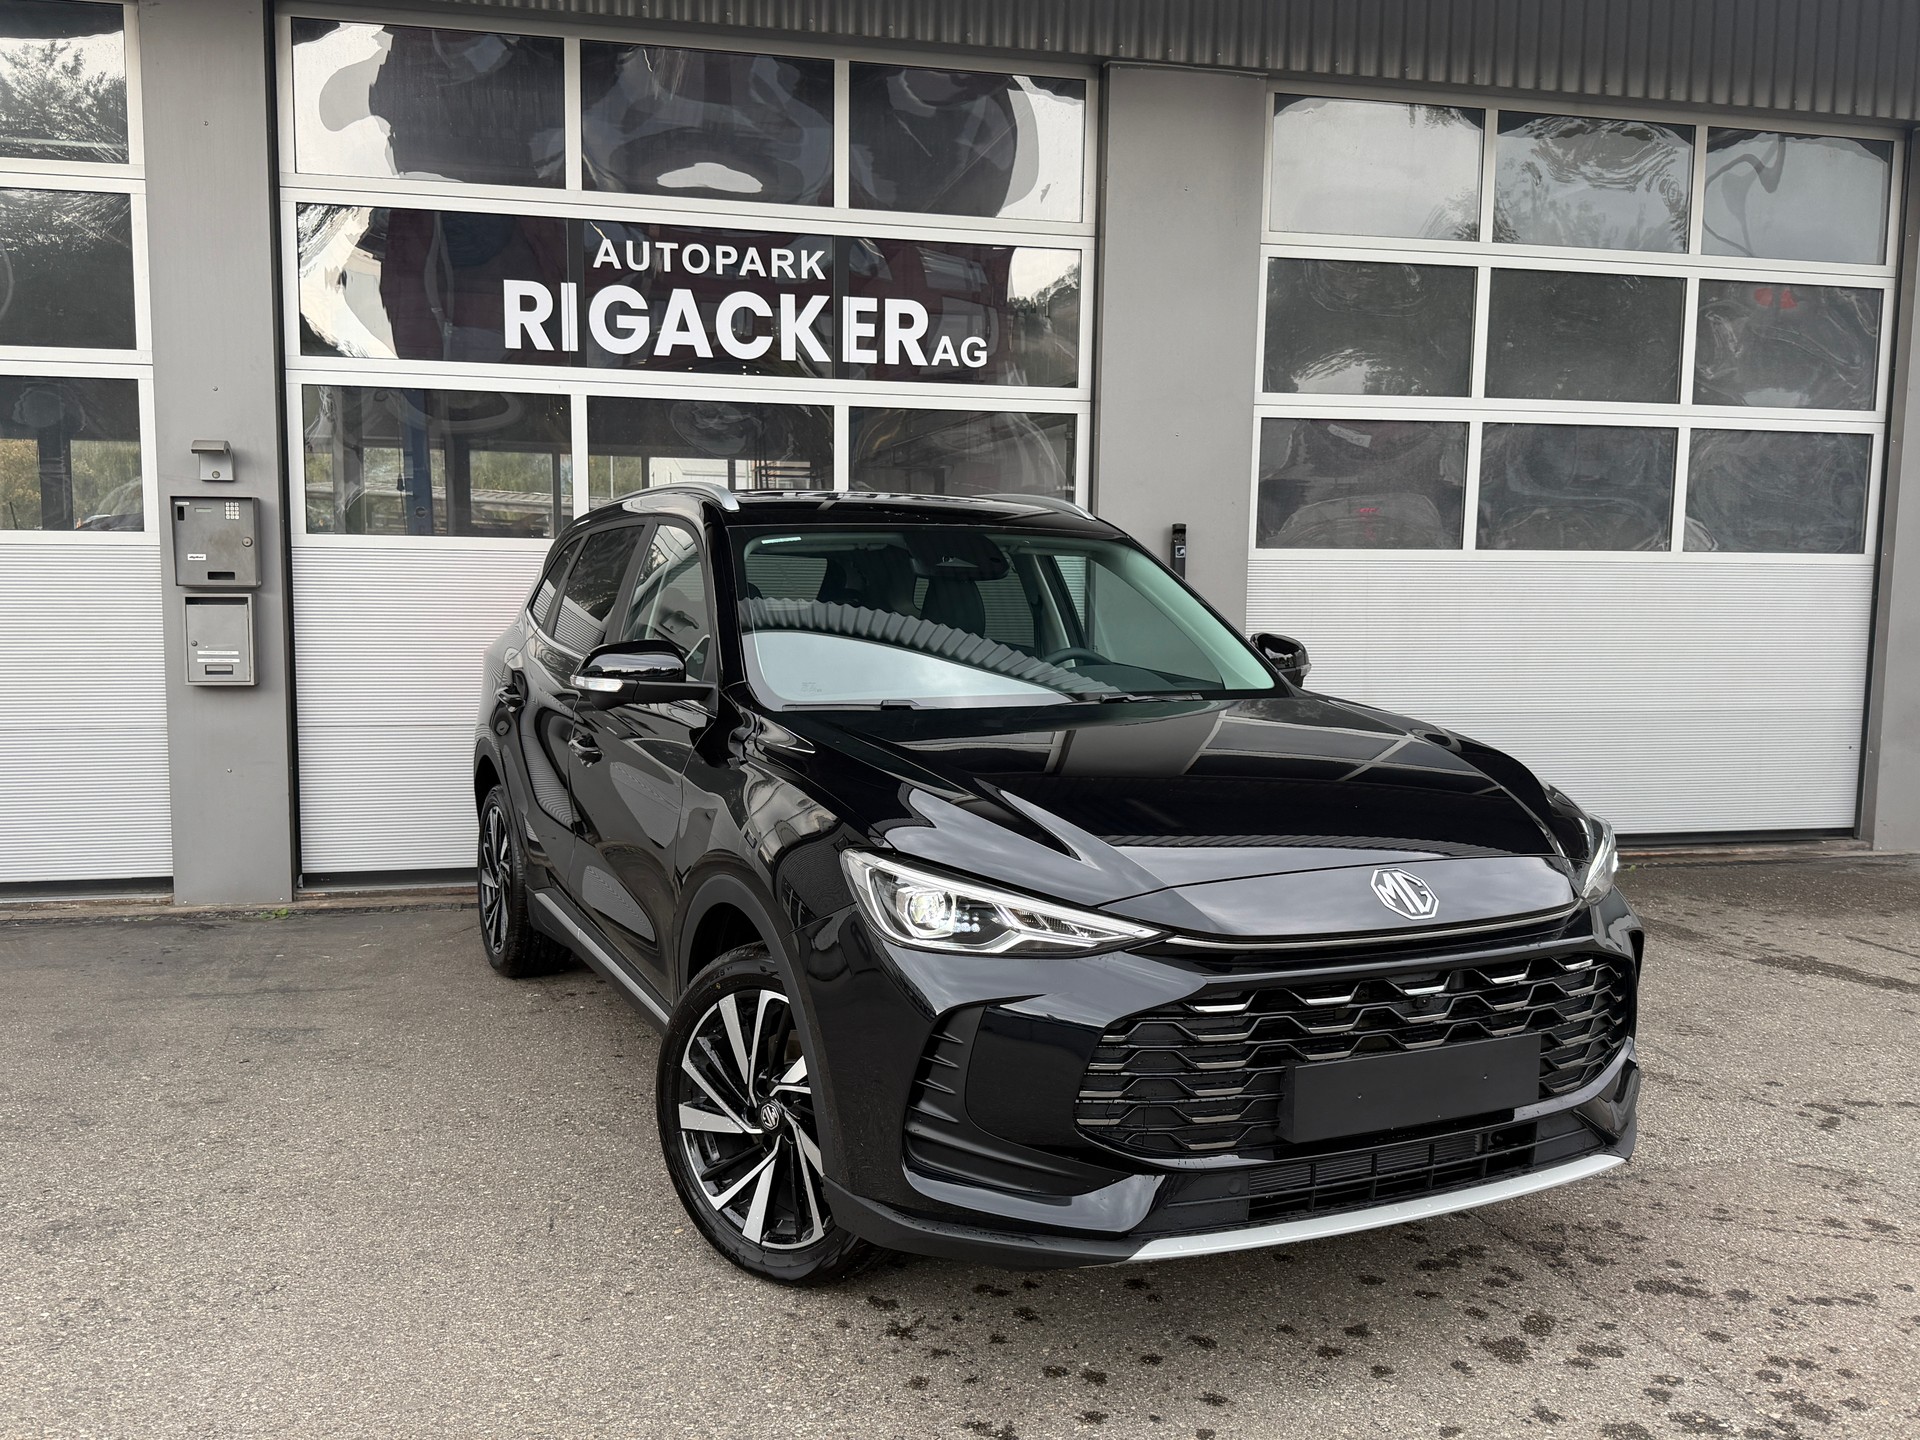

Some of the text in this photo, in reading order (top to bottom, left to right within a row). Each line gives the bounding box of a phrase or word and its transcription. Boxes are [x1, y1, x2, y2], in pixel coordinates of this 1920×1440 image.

[593, 238, 826, 280] AUTOPARK
[503, 279, 988, 368] RIGACKER AG
[1376, 871, 1434, 915] MG
